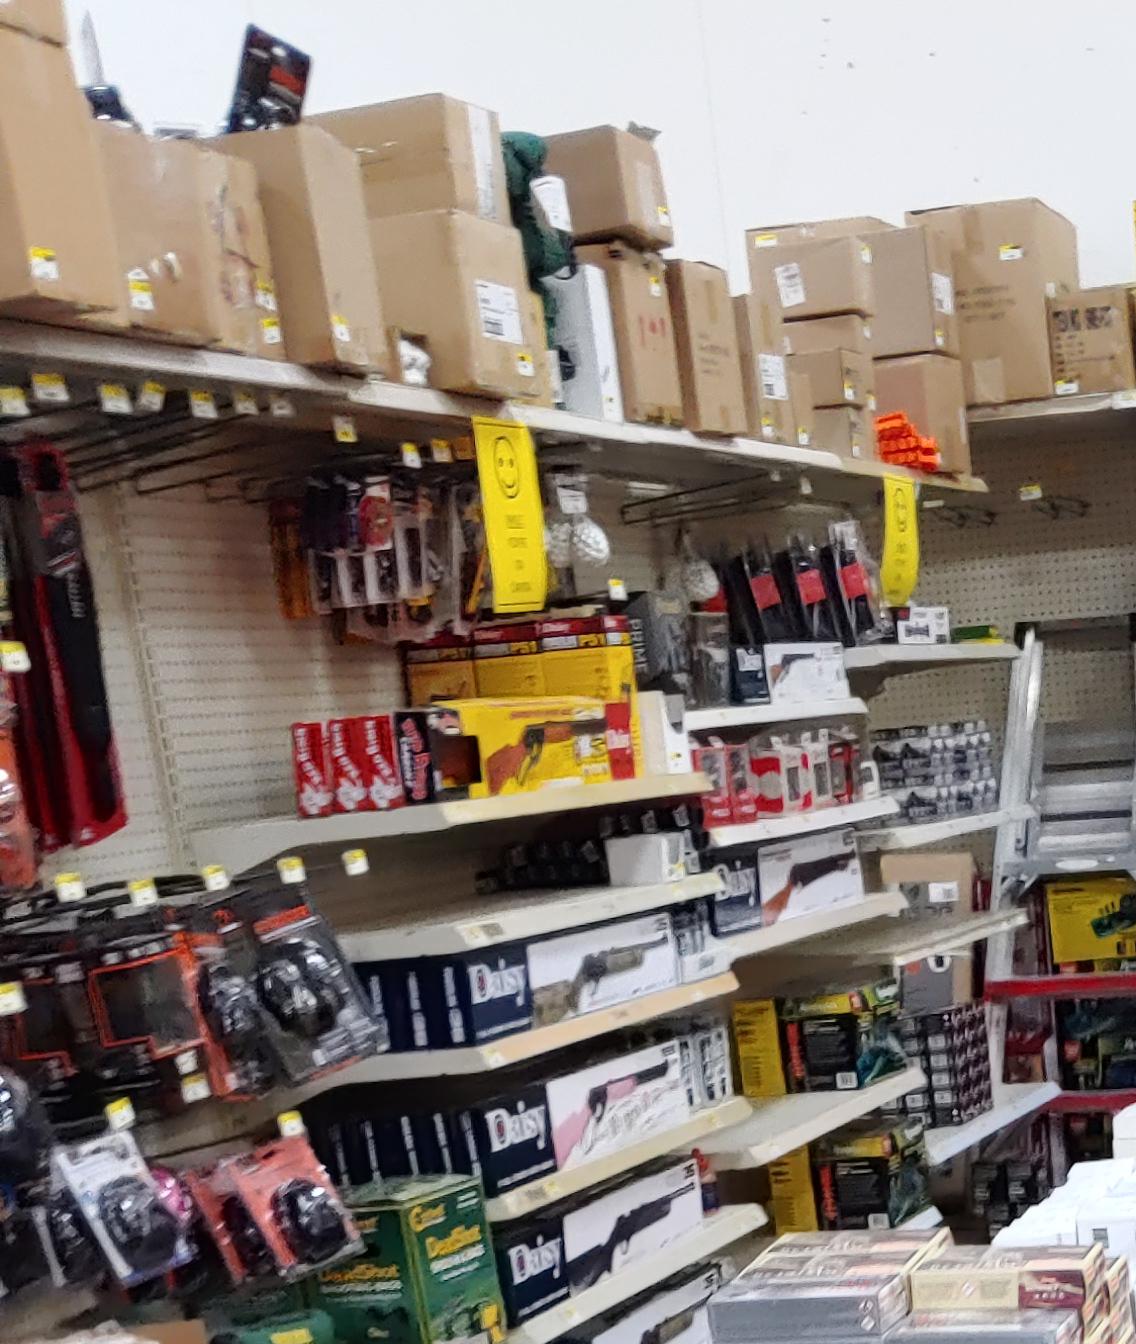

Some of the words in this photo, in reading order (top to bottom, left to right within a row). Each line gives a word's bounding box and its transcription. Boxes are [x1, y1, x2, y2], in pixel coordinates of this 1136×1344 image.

[466, 957, 526, 1007] Daisy
[484, 1100, 546, 1153] Daisy
[507, 1234, 562, 1286] Daisy
